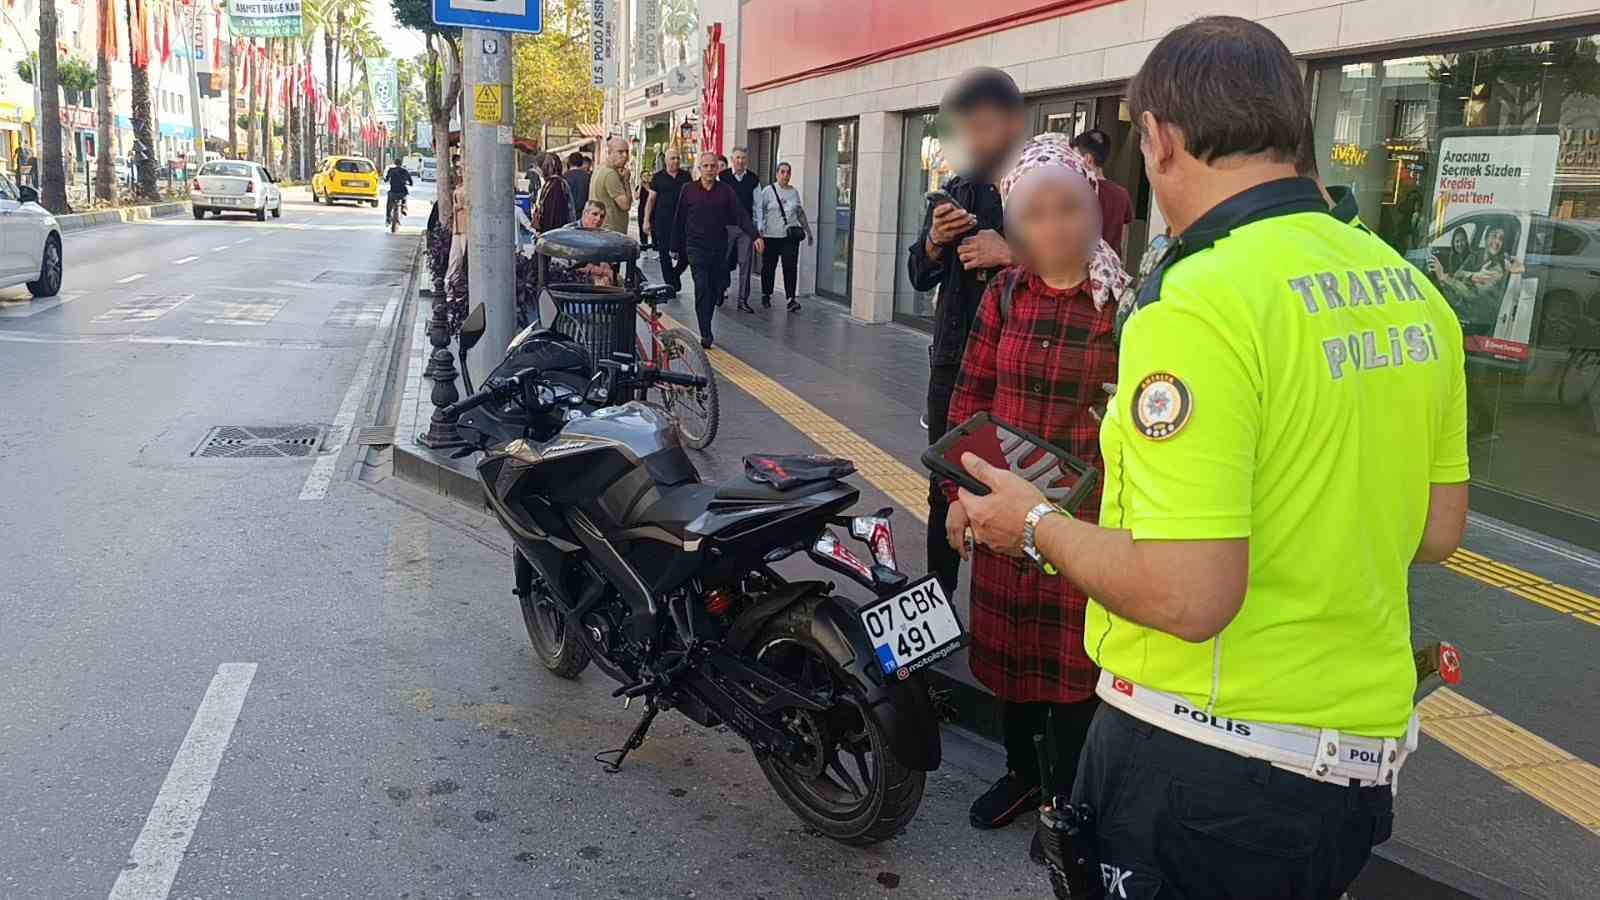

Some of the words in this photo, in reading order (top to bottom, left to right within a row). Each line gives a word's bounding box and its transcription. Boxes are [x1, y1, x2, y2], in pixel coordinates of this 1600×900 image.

[594, 30, 604, 60] POLO
[1441, 164, 1482, 178] Seçmek
[1484, 164, 1522, 177] Sizden
[1443, 151, 1490, 163] Aracınızı
[1440, 177, 1476, 190] Kredisi
[1288, 267, 1425, 313] TRAFİK
[1322, 323, 1438, 380] POLİSİ
[866, 604, 893, 638] 07
[898, 582, 944, 621] CBK
[898, 620, 936, 657] 491
